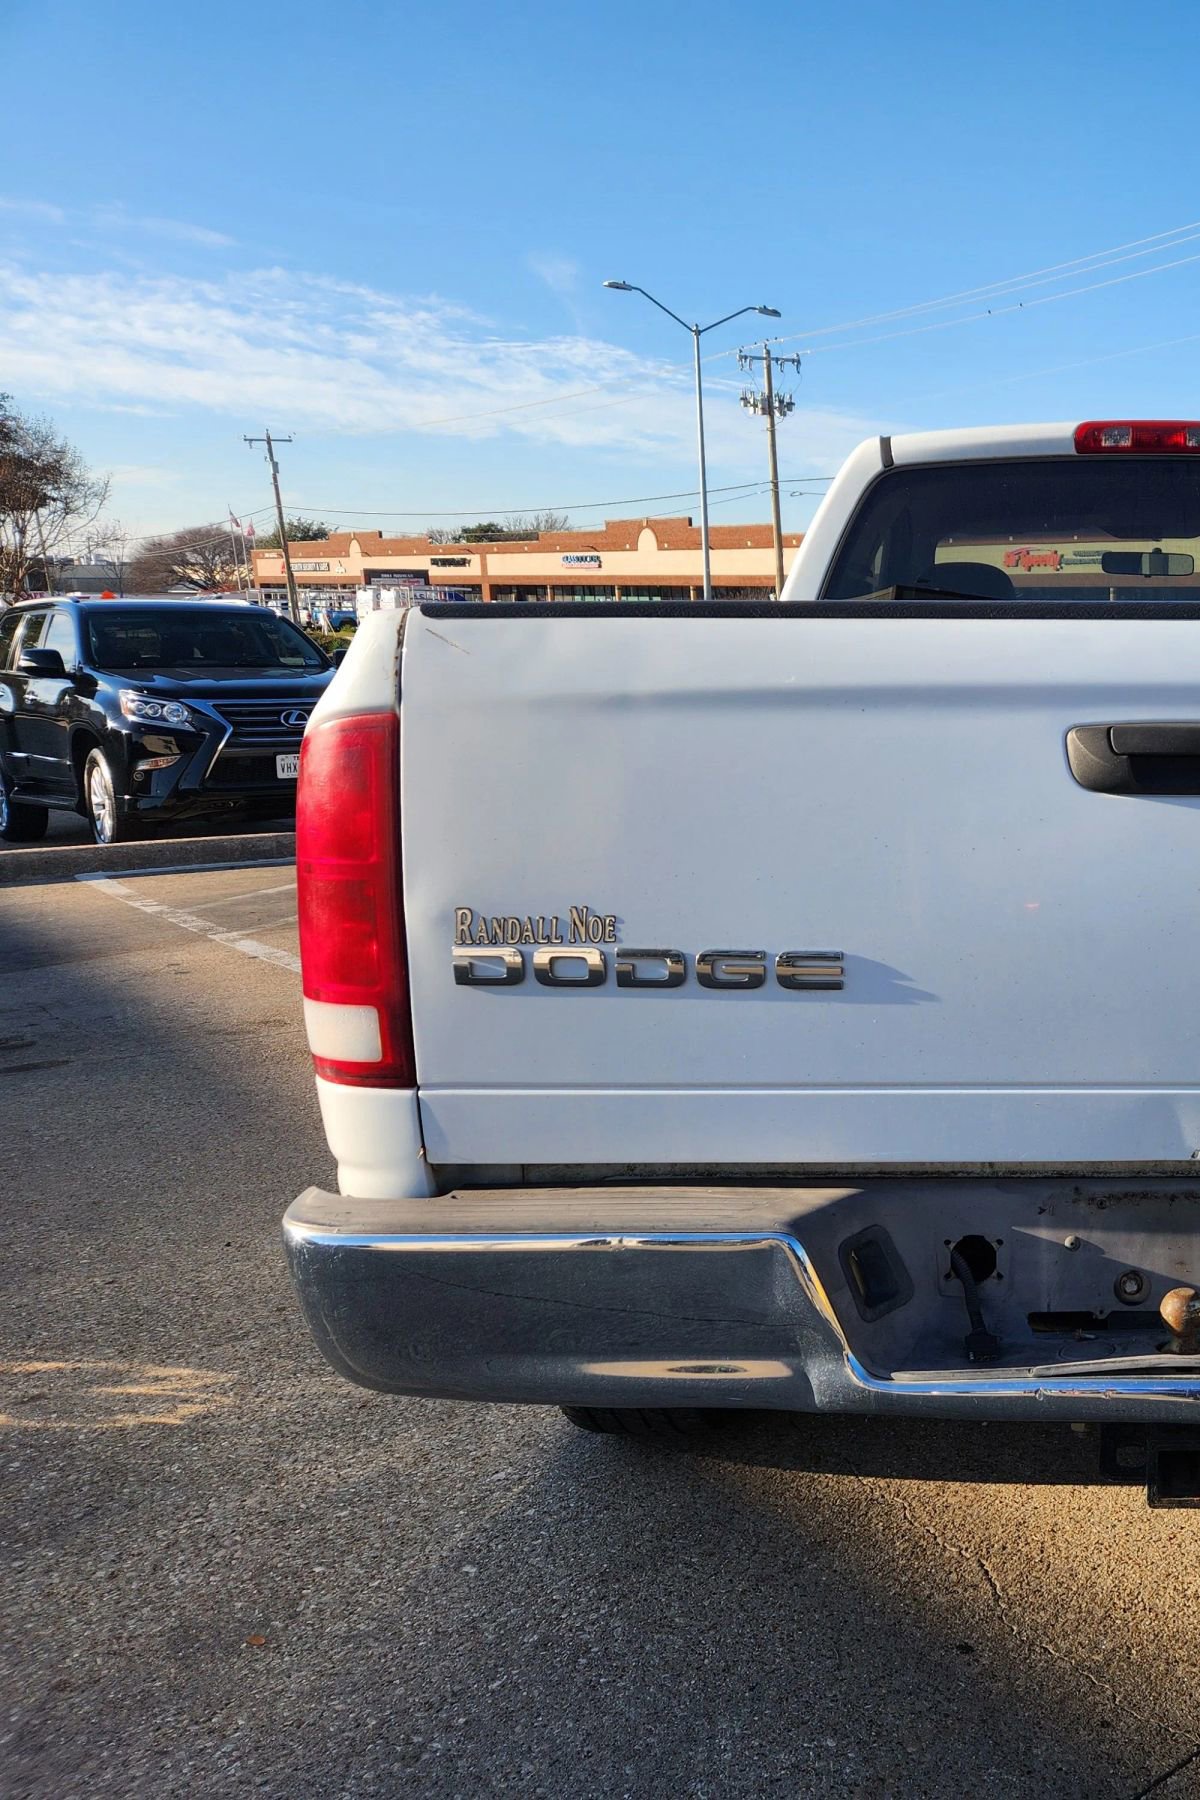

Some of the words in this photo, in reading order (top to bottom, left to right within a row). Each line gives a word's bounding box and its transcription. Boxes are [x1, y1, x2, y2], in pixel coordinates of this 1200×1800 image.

[280, 762, 299, 774] VHX
[568, 906, 617, 944] NOE
[452, 946, 844, 991] DODGE
